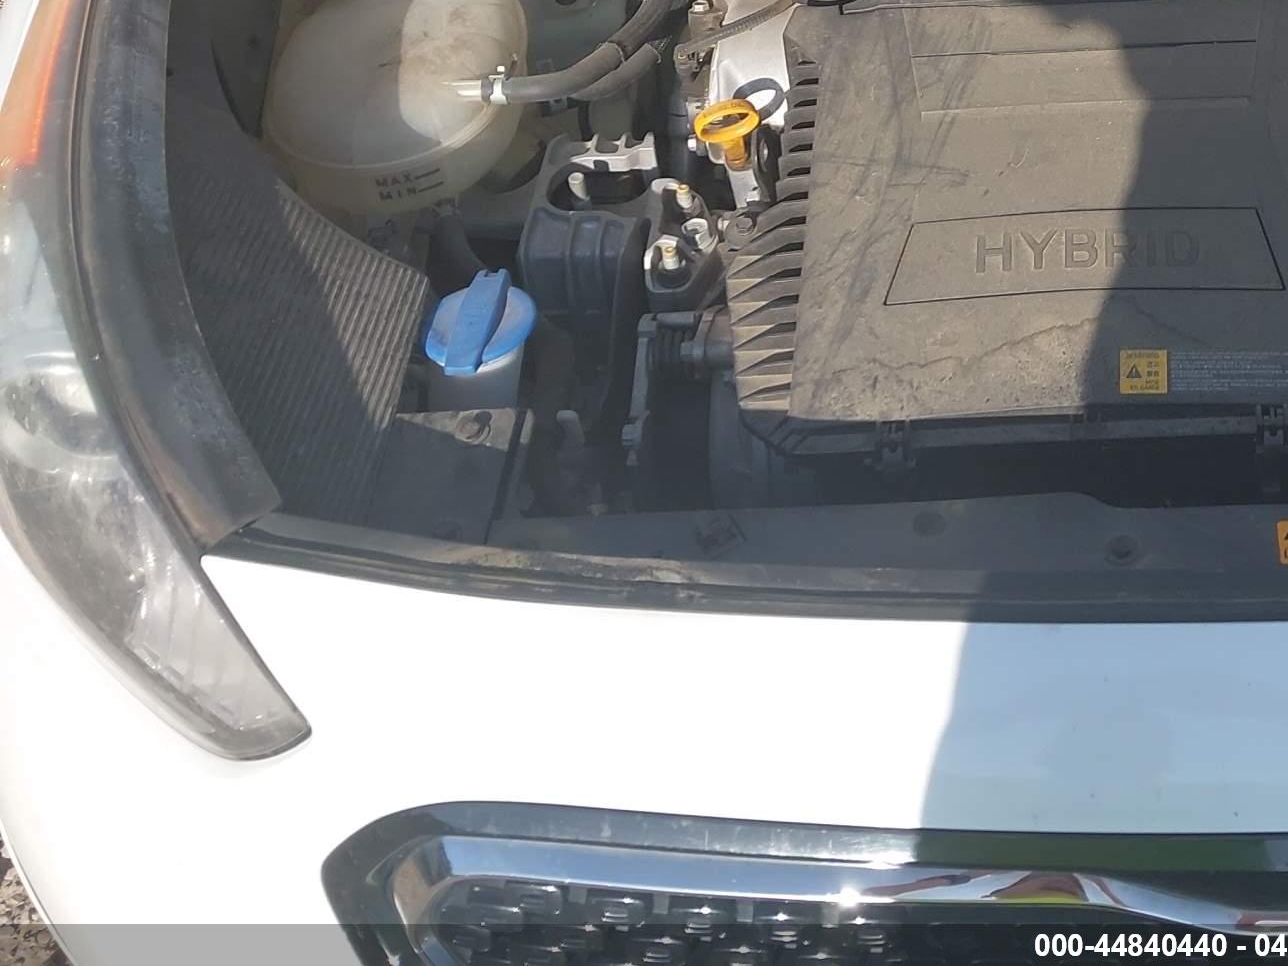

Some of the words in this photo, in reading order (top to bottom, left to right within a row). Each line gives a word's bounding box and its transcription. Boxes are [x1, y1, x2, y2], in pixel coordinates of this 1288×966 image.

[374, 172, 413, 187] MAX
[378, 186, 417, 201] MIN
[975, 227, 1200, 273] HYBRID
